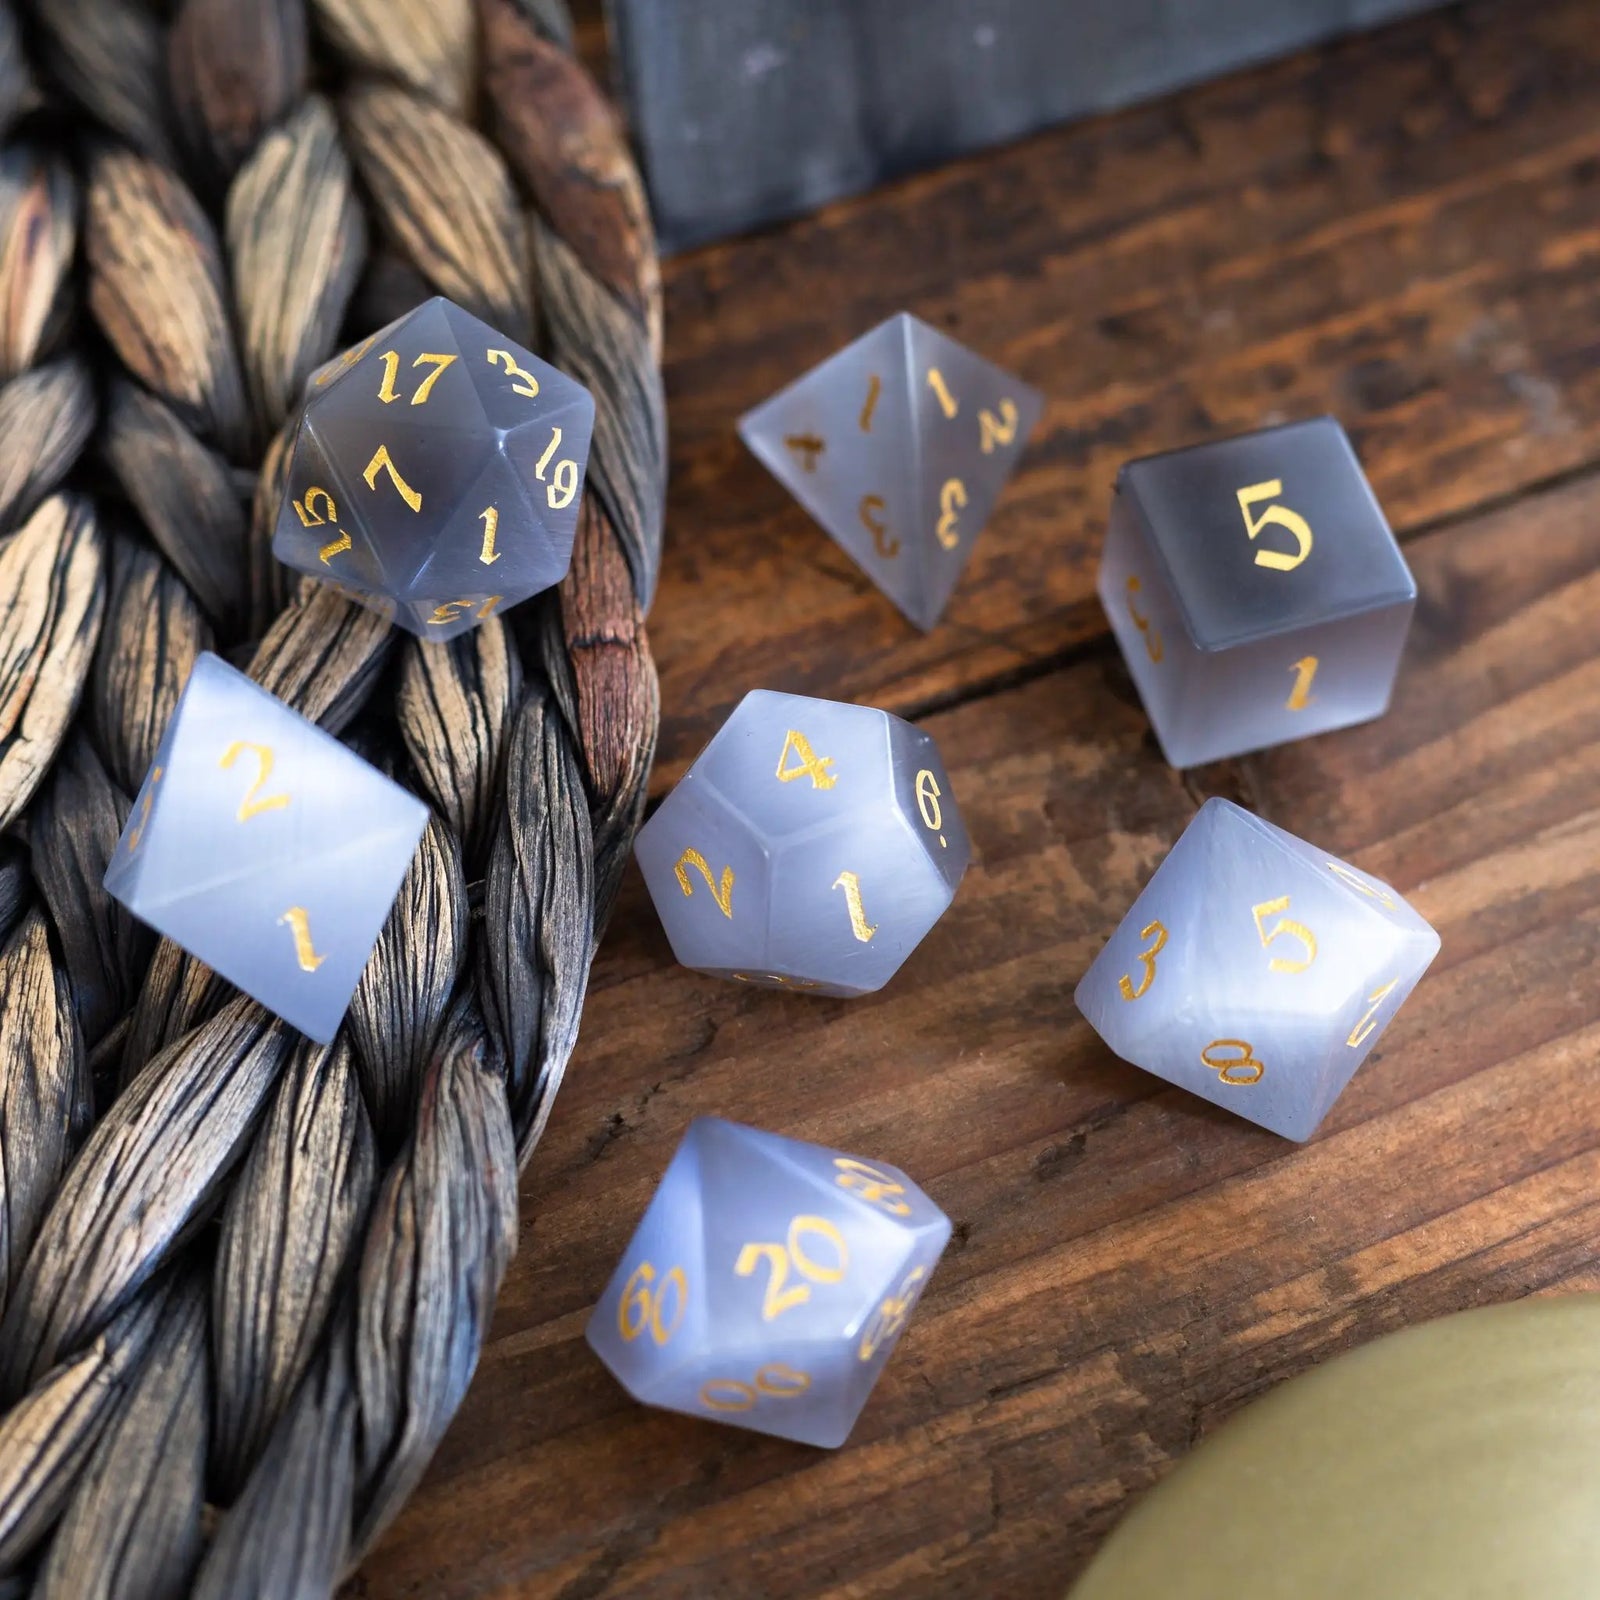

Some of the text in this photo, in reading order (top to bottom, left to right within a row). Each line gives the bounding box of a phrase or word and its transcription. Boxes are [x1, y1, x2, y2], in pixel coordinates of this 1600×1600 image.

[378, 350, 459, 405] 17
[486, 349, 540, 398] 3
[858, 374, 881, 432] 1
[929, 368, 958, 419] 1
[362, 445, 423, 513] 7
[535, 426, 579, 509] 19
[292, 486, 352, 567] 15
[479, 506, 502, 566] 1
[936, 478, 968, 550] 3
[1236, 479, 1313, 571] 5
[1285, 656, 1319, 712] 1
[218, 740, 292, 823] 2
[776, 729, 838, 789] 4
[674, 847, 736, 920] 2
[832, 871, 879, 943] 1
[277, 905, 328, 973] 1
[1118, 920, 1169, 1002] 3
[1251, 896, 1318, 975] 5
[1200, 1038, 1265, 1086] 8
[617, 1261, 690, 1347] 60
[733, 1214, 848, 1322] 20
